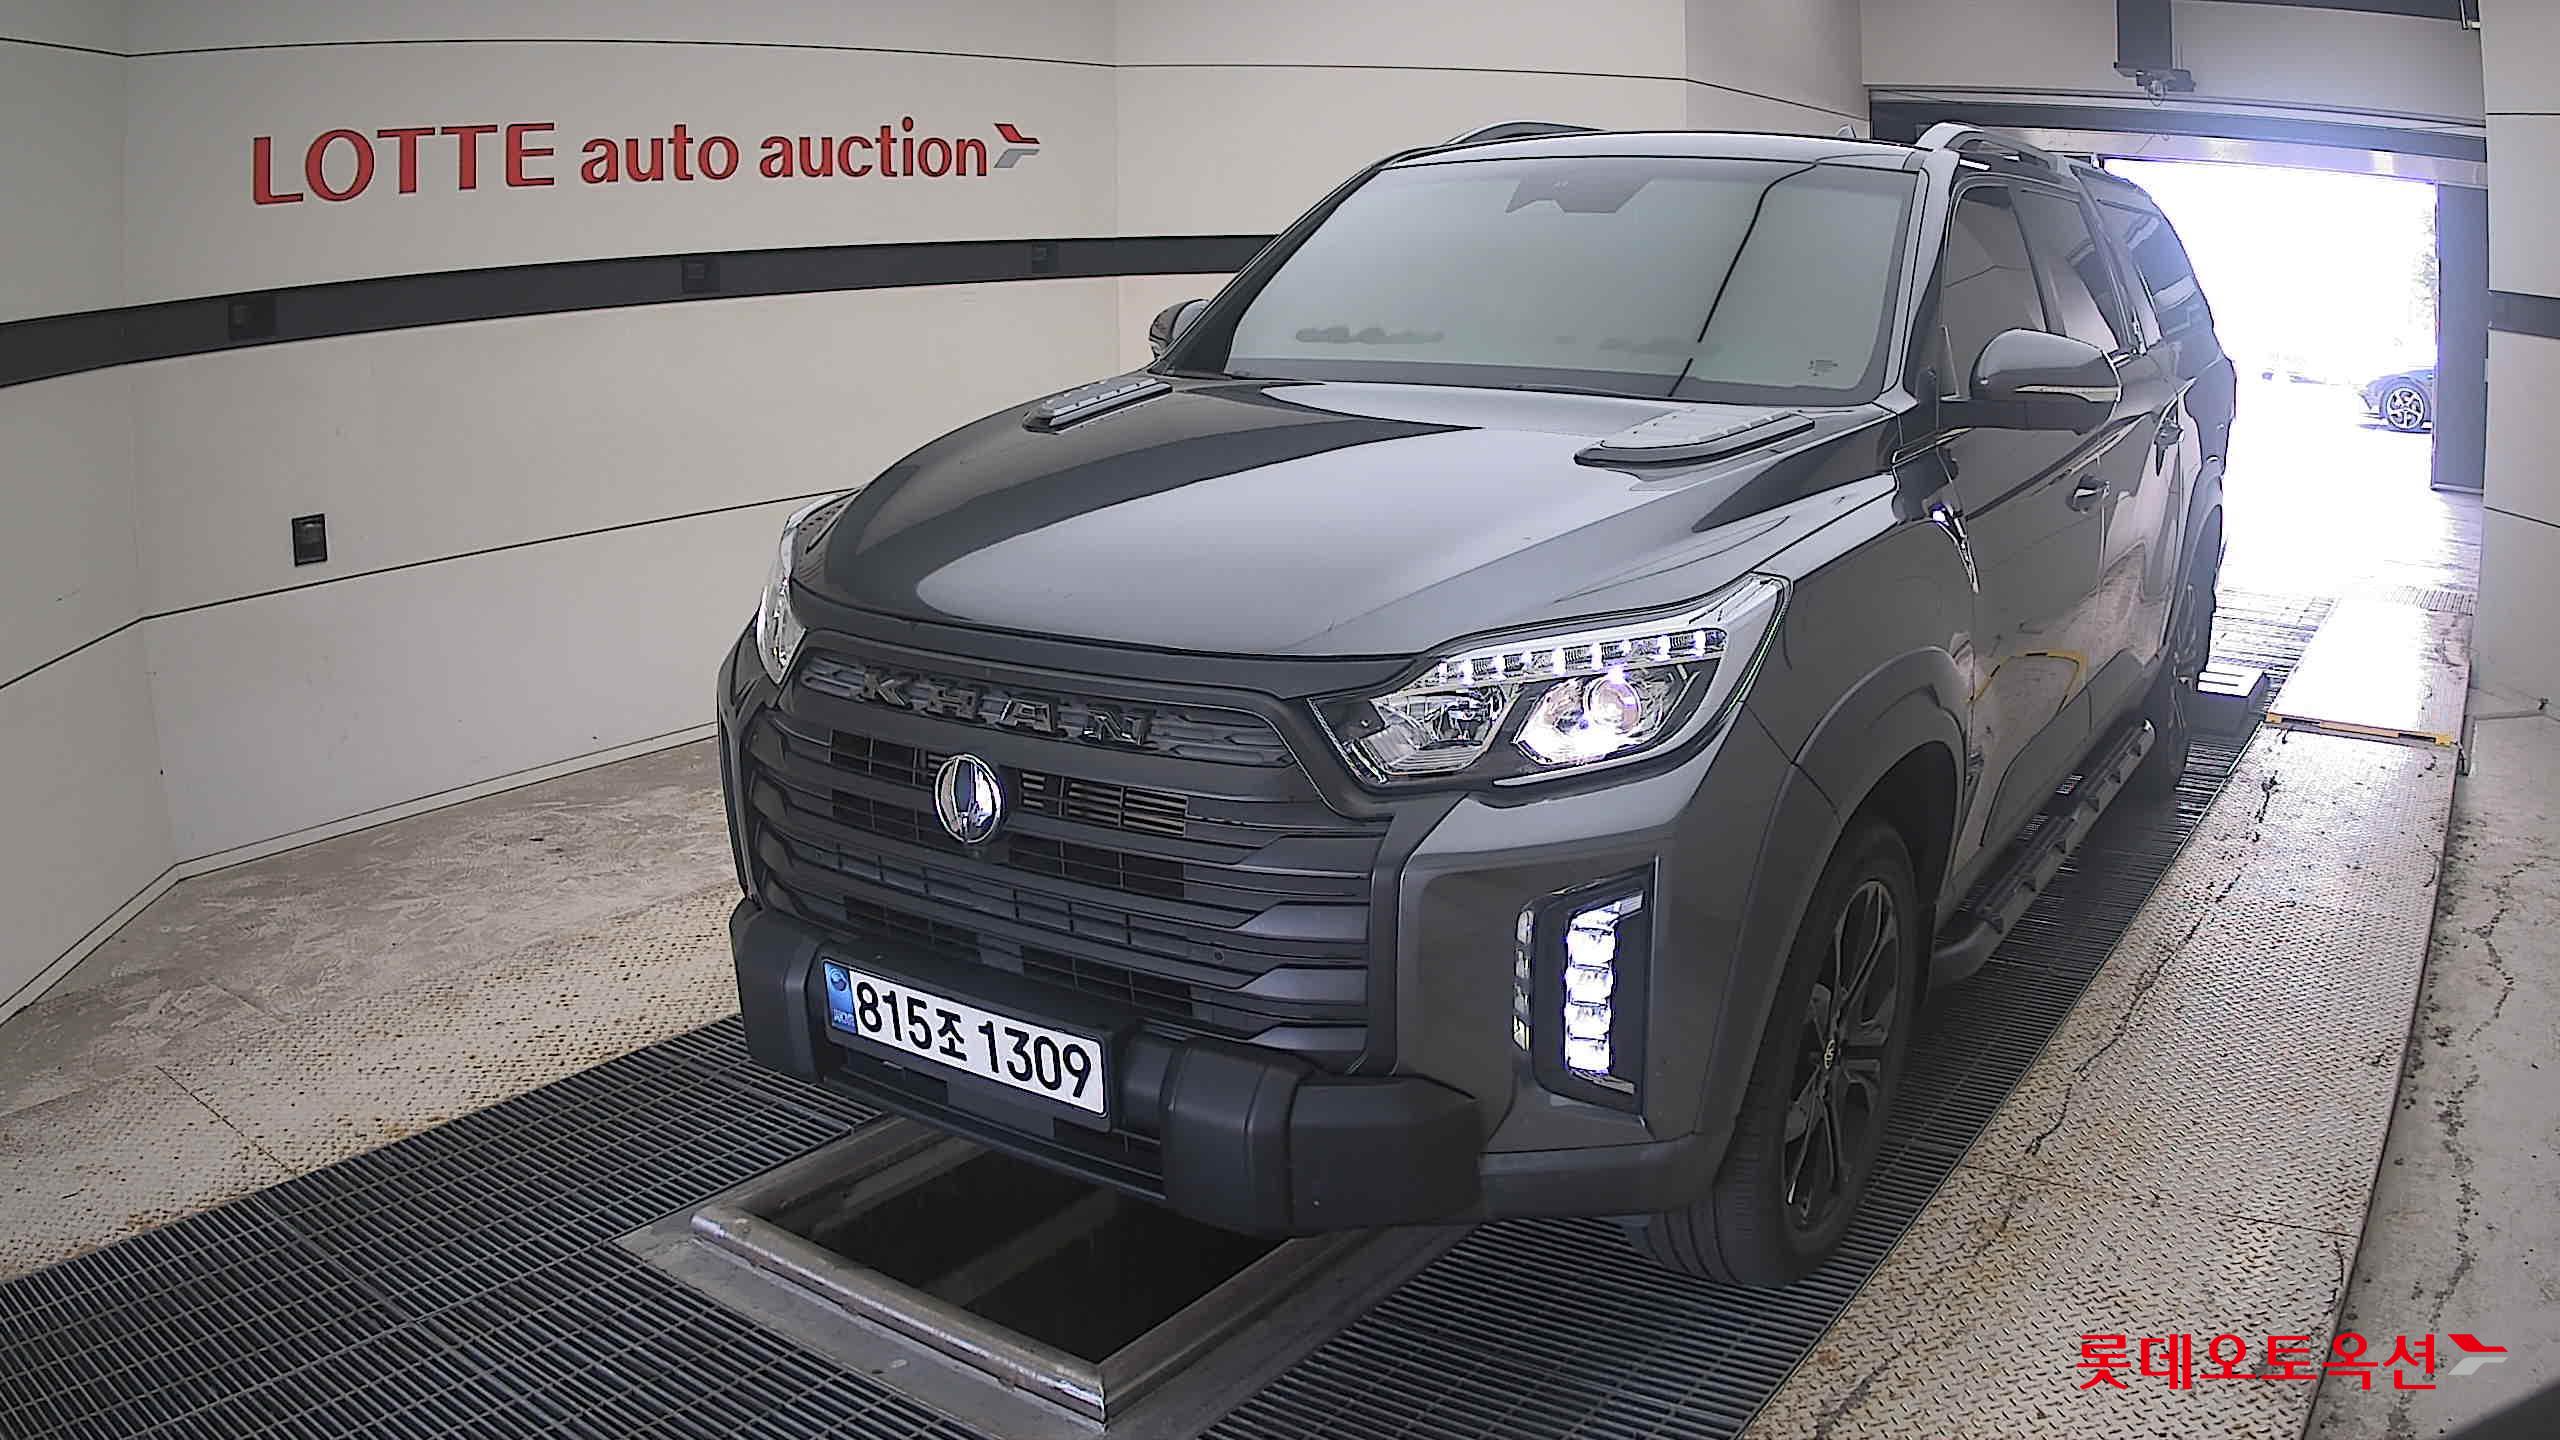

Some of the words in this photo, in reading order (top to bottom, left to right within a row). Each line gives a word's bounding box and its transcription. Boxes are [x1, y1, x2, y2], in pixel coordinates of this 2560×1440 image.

[252, 122, 556, 206] LOTTE
[580, 124, 741, 184] auto
[759, 117, 987, 178] auction
[863, 668, 1153, 746] KHAN
[856, 981, 967, 1061] 815조
[978, 1020, 1092, 1098] 1309
